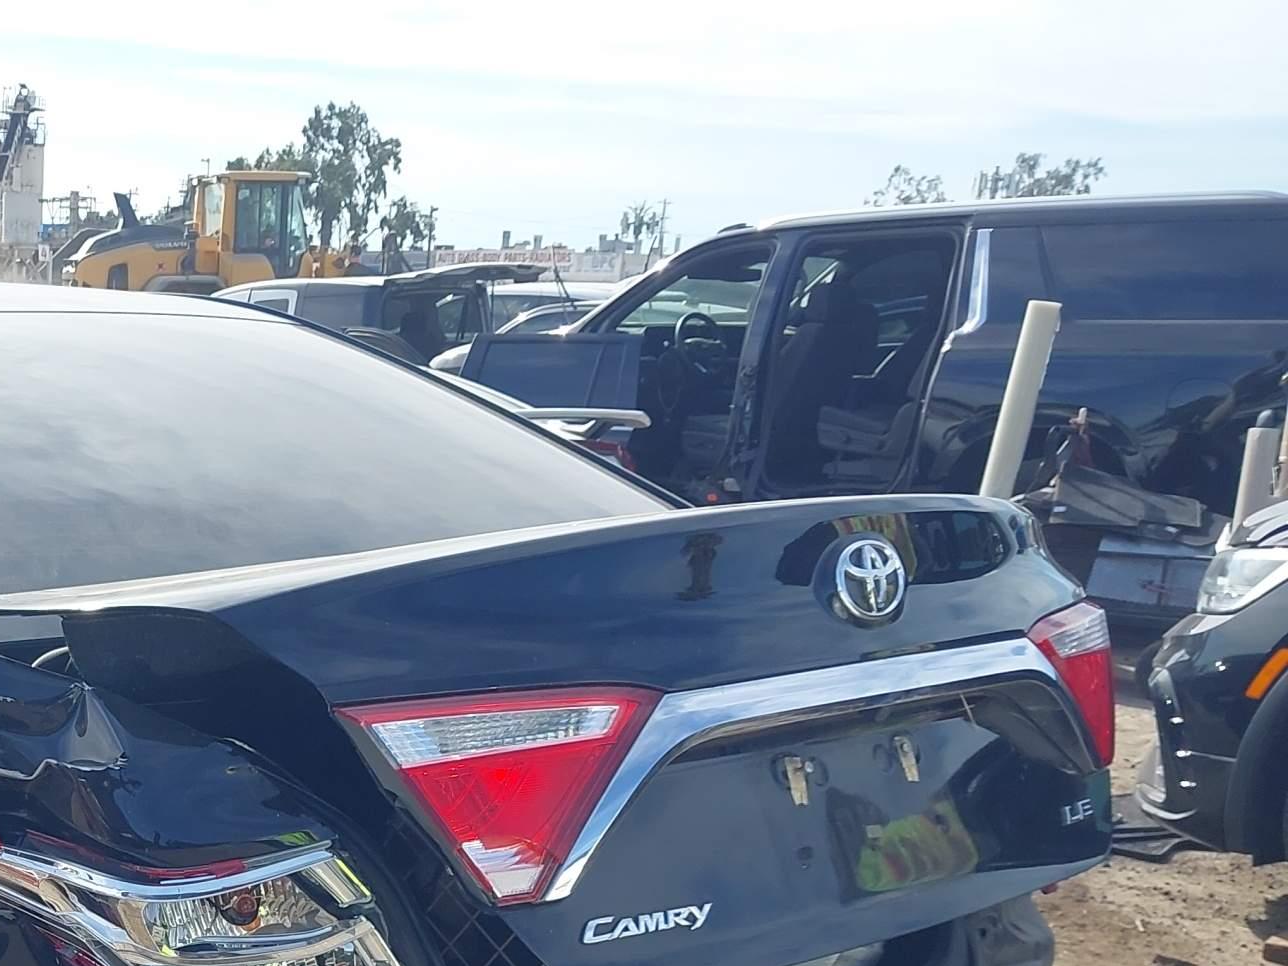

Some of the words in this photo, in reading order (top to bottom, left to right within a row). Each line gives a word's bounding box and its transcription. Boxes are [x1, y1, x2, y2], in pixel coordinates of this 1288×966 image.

[40, 247, 47, 259] 4
[1064, 799, 1093, 825] LE
[582, 902, 713, 944] CAMRY
